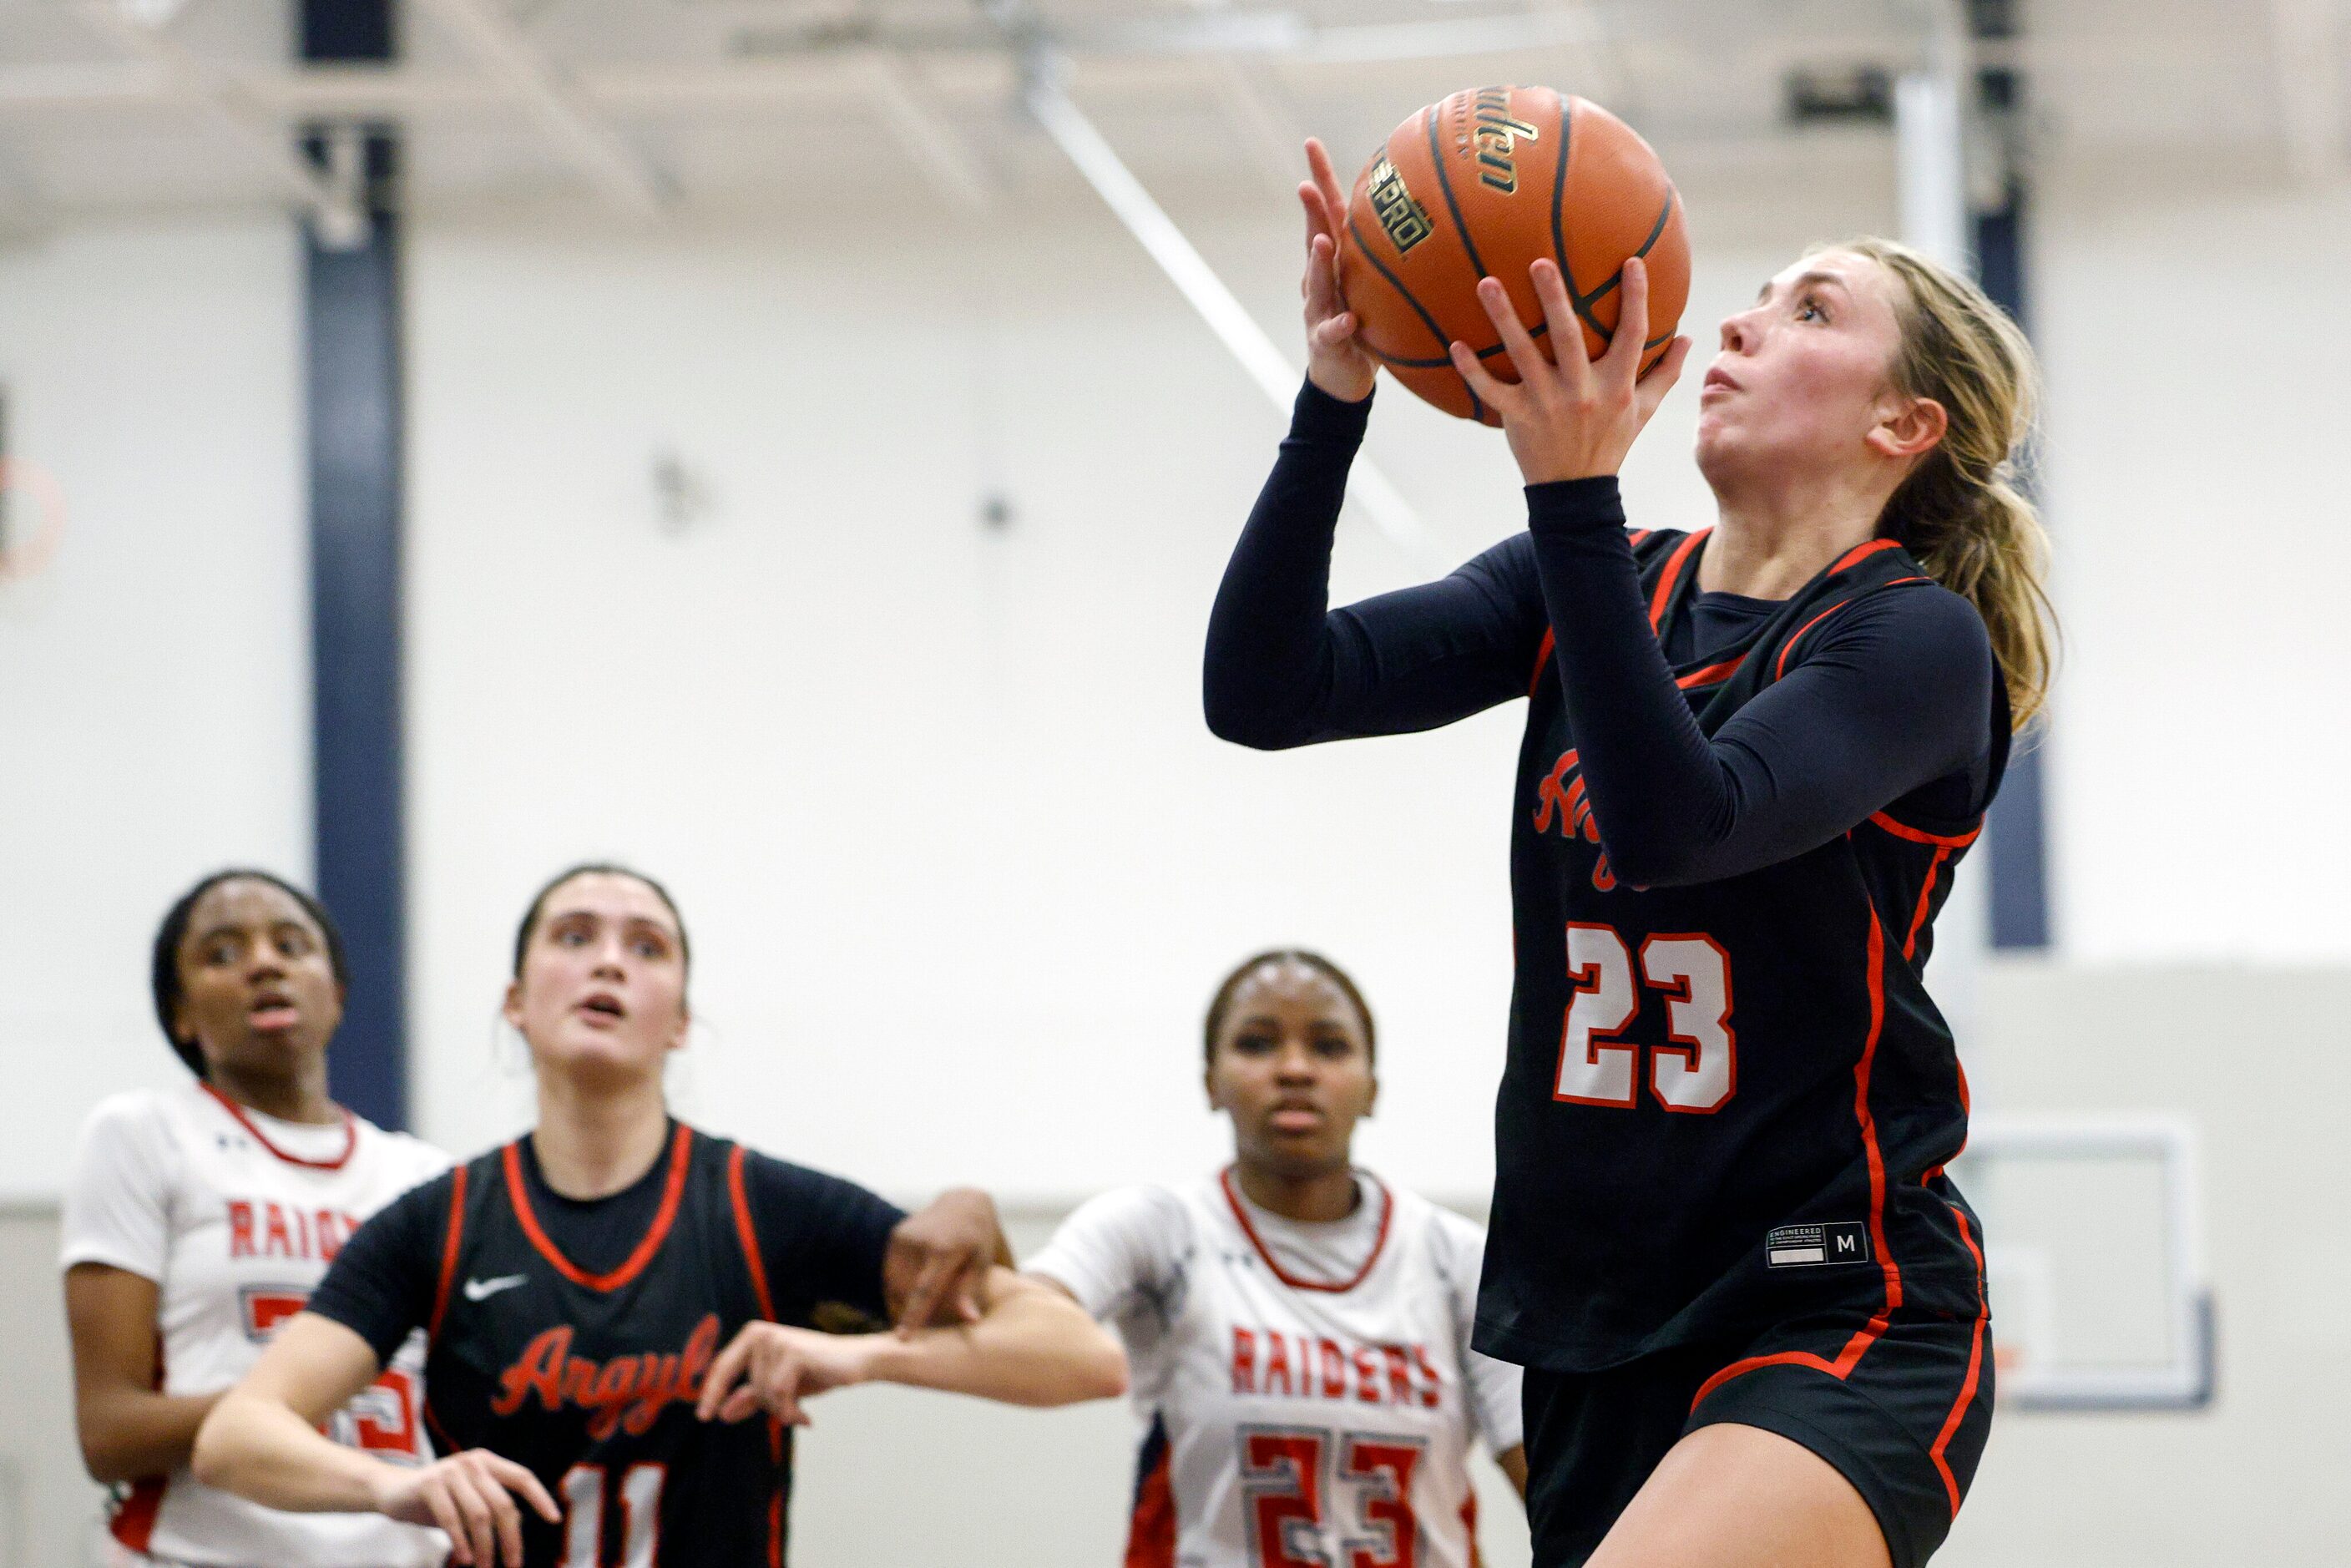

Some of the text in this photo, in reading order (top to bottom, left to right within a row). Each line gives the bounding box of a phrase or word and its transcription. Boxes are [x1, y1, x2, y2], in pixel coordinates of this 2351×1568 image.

[1552, 921, 1737, 1115] 23
[228, 1199, 361, 1262] RAID
[1769, 1227, 1822, 1238] ENGINEERED
[1837, 1235, 1855, 1252] M
[491, 1313, 721, 1441] Argyl
[1231, 1324, 1441, 1410] RAIDERS
[557, 1461, 667, 1568] 11
[1236, 1423, 1430, 1568] 23
